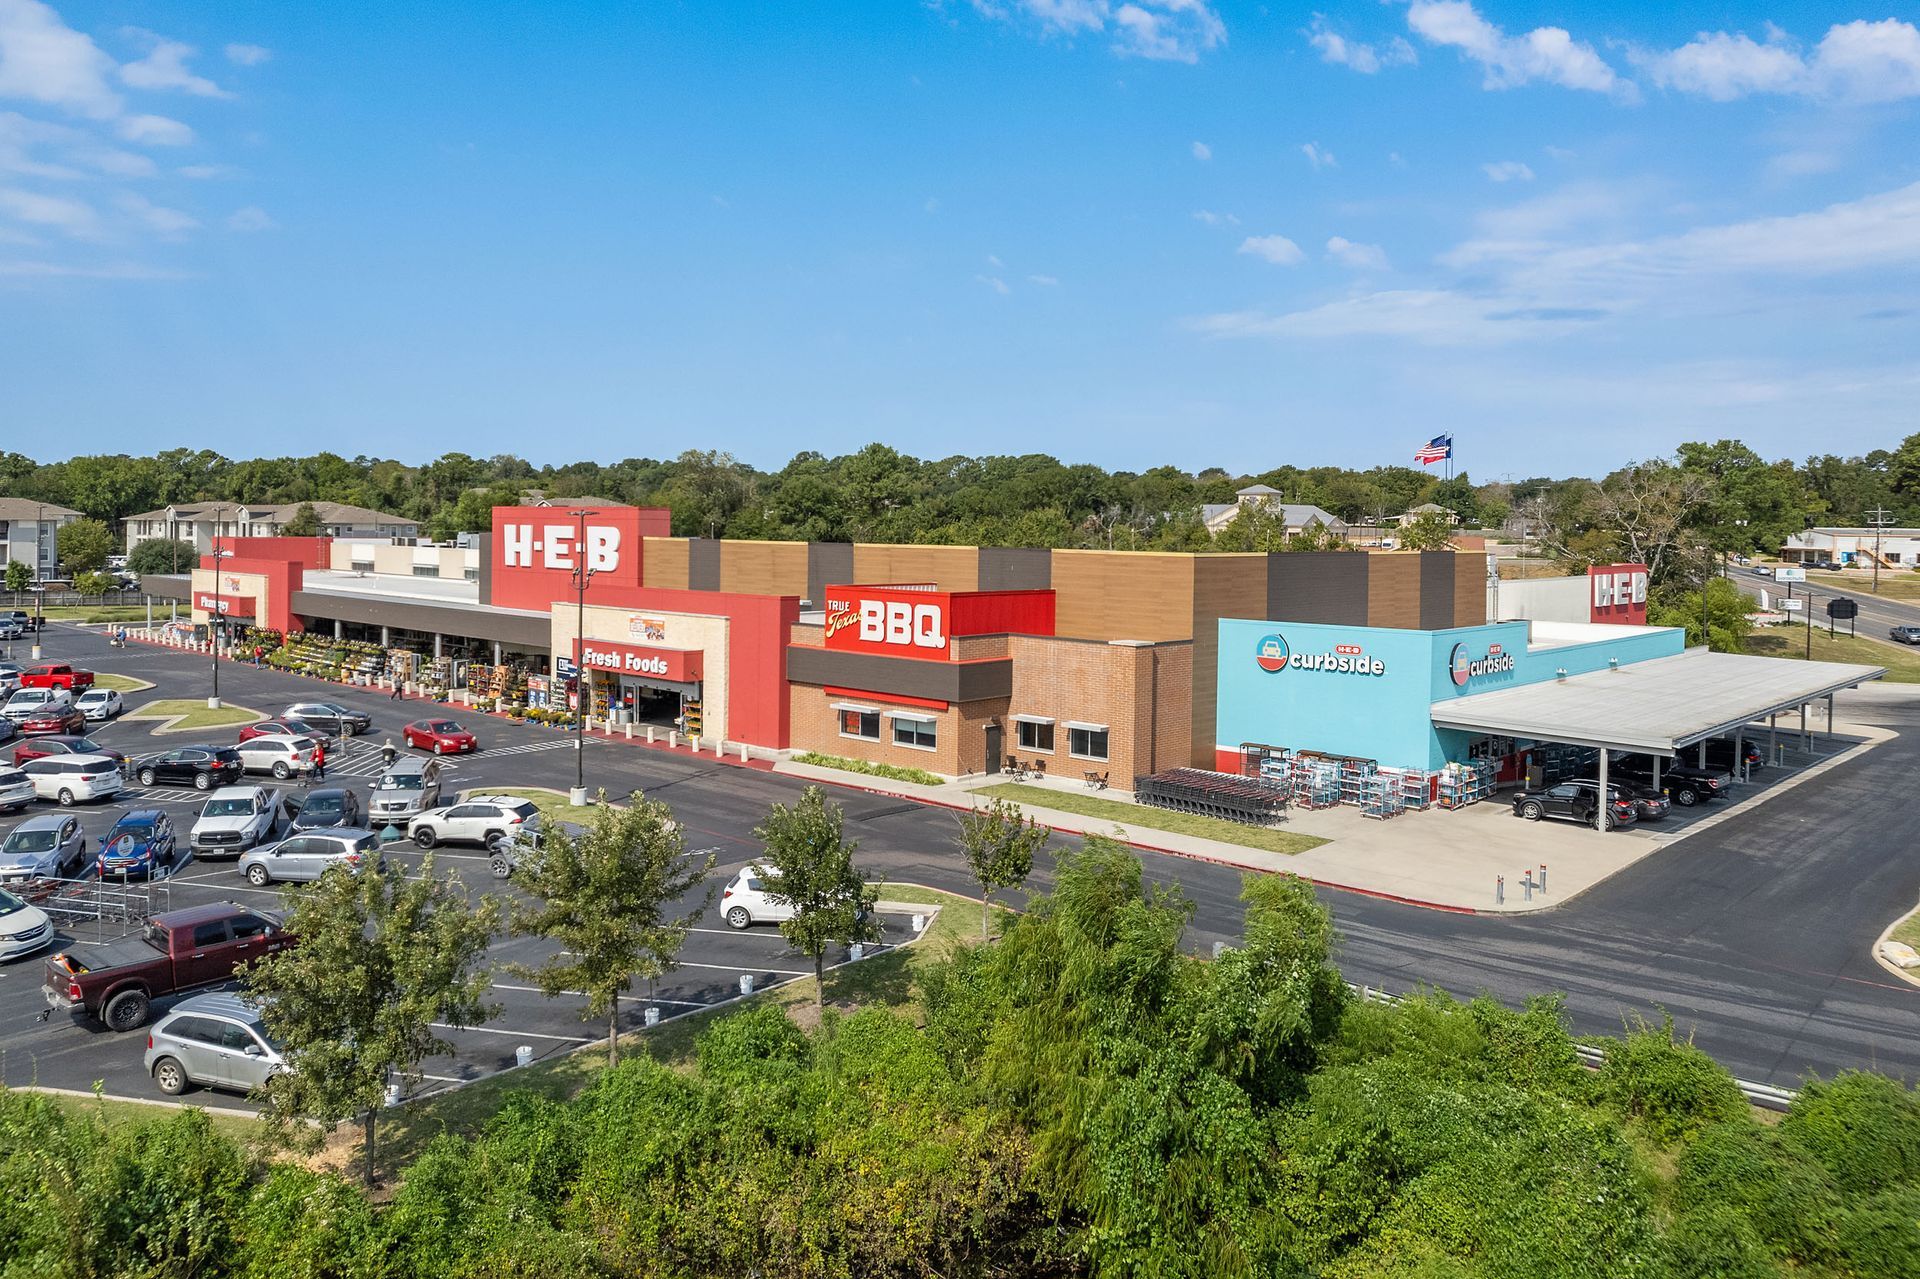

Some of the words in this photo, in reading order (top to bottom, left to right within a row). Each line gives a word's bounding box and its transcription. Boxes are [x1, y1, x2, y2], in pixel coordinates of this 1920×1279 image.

[827, 600, 850, 612] TRUE
[826, 608, 862, 638] Texas
[859, 599, 946, 649] BBQ
[582, 647, 620, 669] Fresh
[625, 652, 668, 675] Foods
[1289, 652, 1386, 676] curbside
[1470, 654, 1514, 677] curbside
